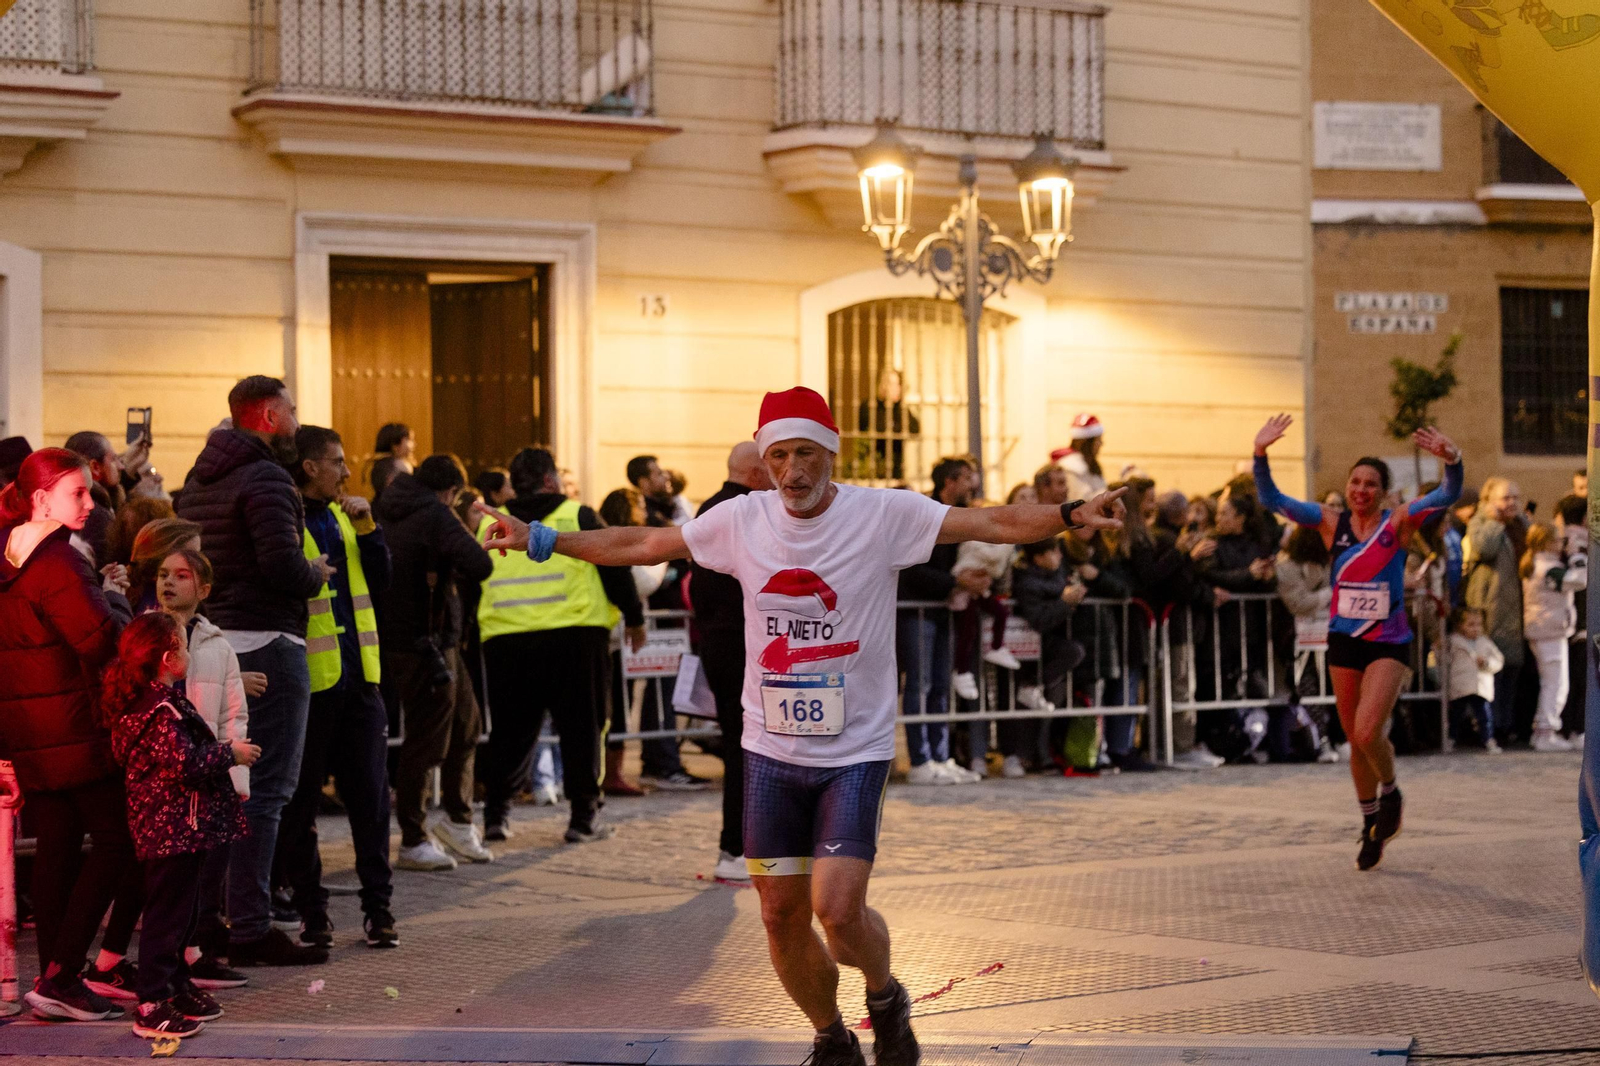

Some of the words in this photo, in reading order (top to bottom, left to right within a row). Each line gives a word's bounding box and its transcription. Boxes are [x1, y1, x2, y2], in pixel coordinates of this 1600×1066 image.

[1350, 598, 1378, 611] 722
[766, 616, 782, 636] EL
[787, 619, 834, 640] NIETO
[779, 699, 824, 722] 168
